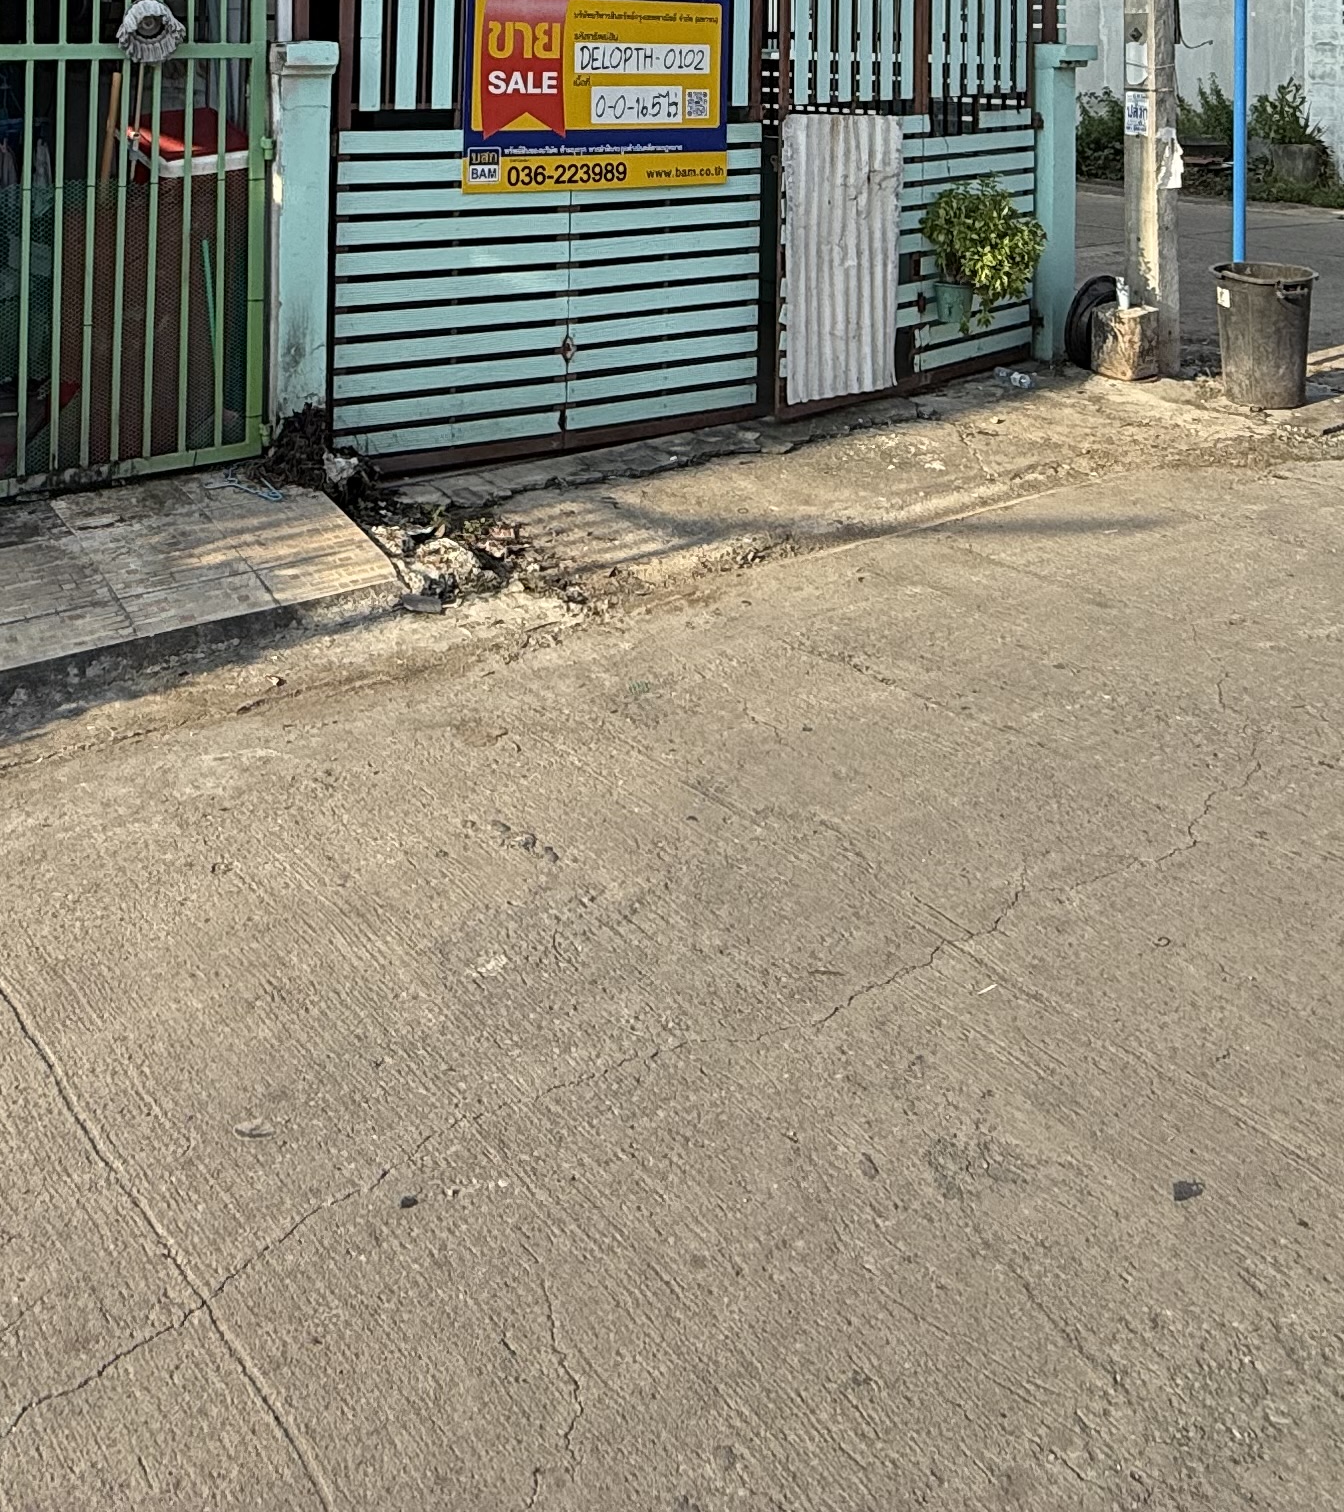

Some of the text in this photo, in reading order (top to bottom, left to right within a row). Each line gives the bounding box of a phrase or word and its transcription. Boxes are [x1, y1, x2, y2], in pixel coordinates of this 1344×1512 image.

[488, 20, 561, 59] ขาย
[488, 70, 558, 95] SALE
[471, 167, 498, 180] BAM
[507, 162, 627, 187] 036-223989
[646, 166, 724, 179] www.bam.co.th
